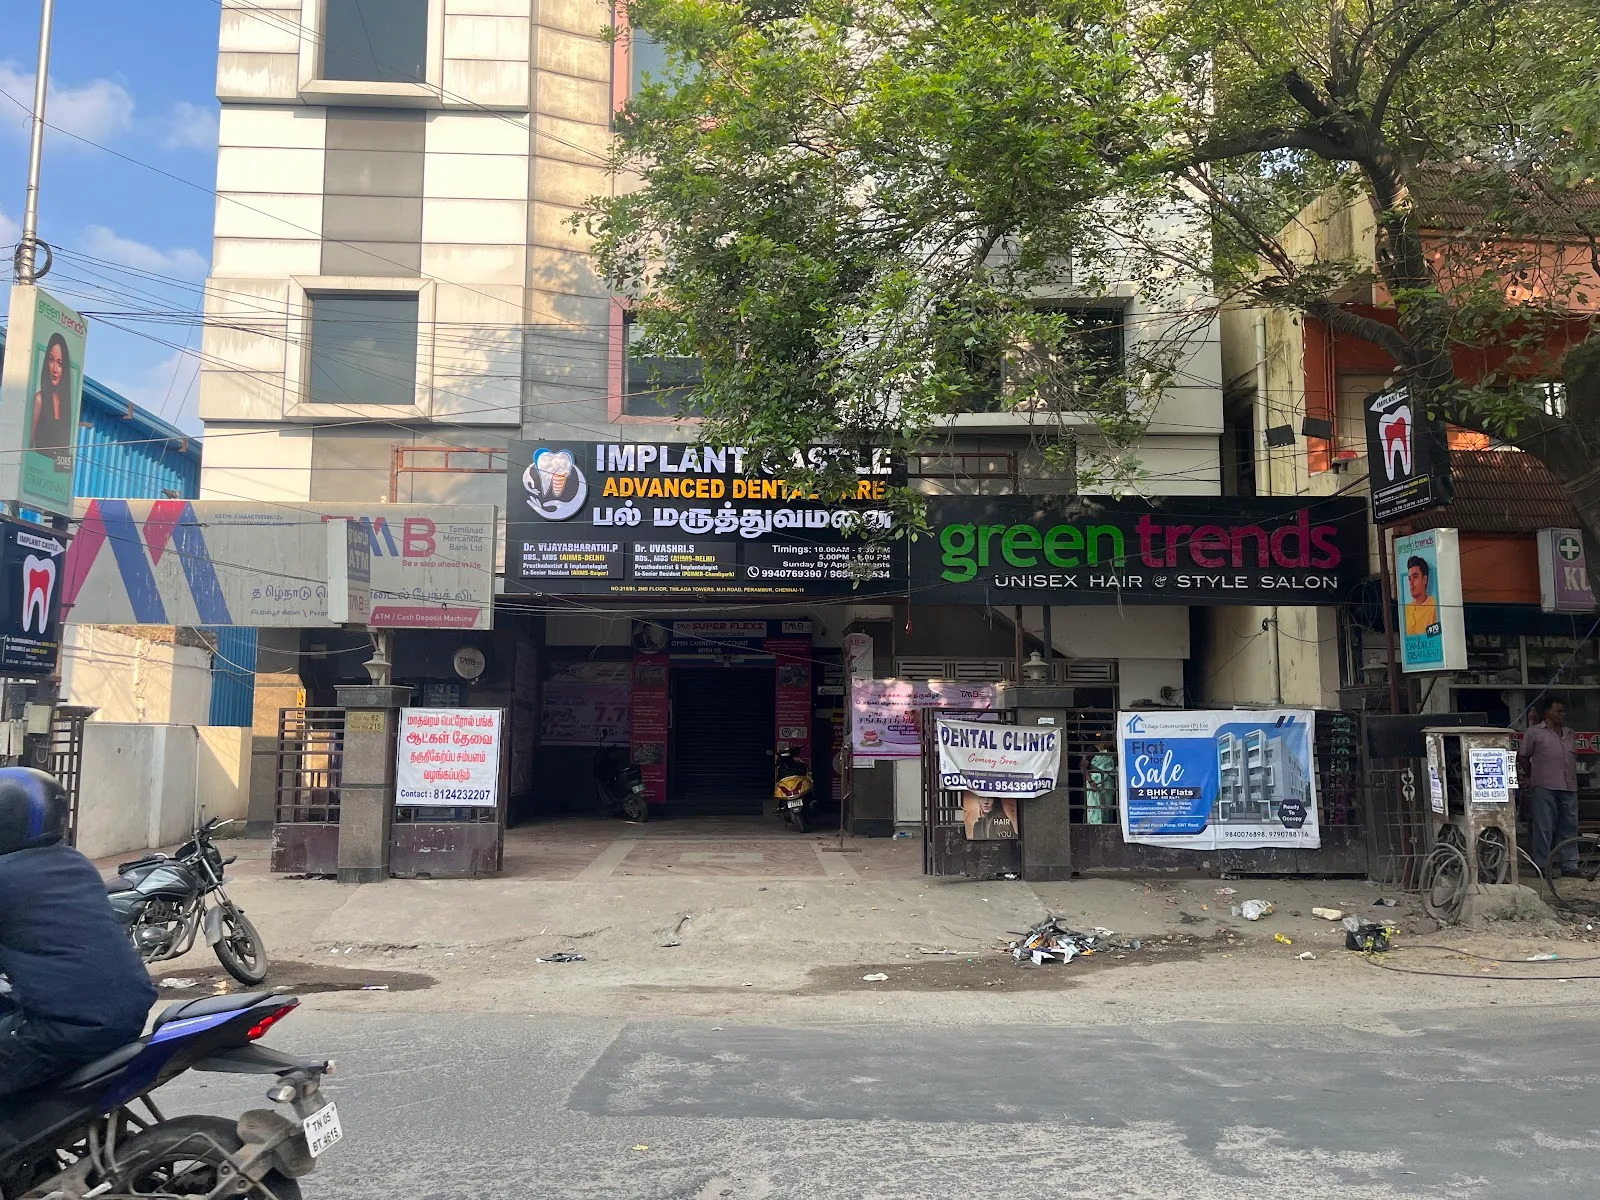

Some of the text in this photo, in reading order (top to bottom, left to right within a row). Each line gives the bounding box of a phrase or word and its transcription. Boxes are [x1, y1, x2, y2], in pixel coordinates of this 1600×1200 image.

[39, 300, 83, 335] green trends
[597, 445, 748, 473] IMPLANT
[603, 477, 725, 499] ADVANCED
[593, 500, 642, 527] பல்
[449, 526, 483, 534] Tamilnad
[20, 535, 41, 548] IMPLANT
[470, 544, 483, 552] Ltd
[524, 543, 536, 552] Dr.
[634, 544, 695, 553] Dr. UVASHRI.S
[940, 509, 1338, 582] green trends
[772, 545, 812, 555] Timings:
[348, 549, 369, 571] ATM
[783, 561, 814, 569] Sunday
[817, 561, 829, 569] By
[762, 570, 822, 578] 9940769390
[995, 574, 1079, 589] UNISEX
[1089, 574, 1143, 589] HAIR
[1177, 574, 1249, 589] STYLE
[1260, 574, 1338, 589] SALON
[416, 614, 441, 622] Deposit
[408, 714, 494, 728] மாதவரம் பெட்ரோல் பங்க்
[406, 731, 493, 747] ஆட்கள் தேவை
[941, 727, 1056, 752] DENTAL CLINIC
[1132, 741, 1165, 754] Flat
[457, 750, 486, 763] சம்பளம்
[968, 753, 997, 768] Coming
[1131, 750, 1185, 788] Sale
[401, 789, 491, 800] Contact 8124232207
[994, 818, 1010, 826] HAIR
[312, 1112, 331, 1132] TN 05
[313, 1138, 322, 1153] BT
